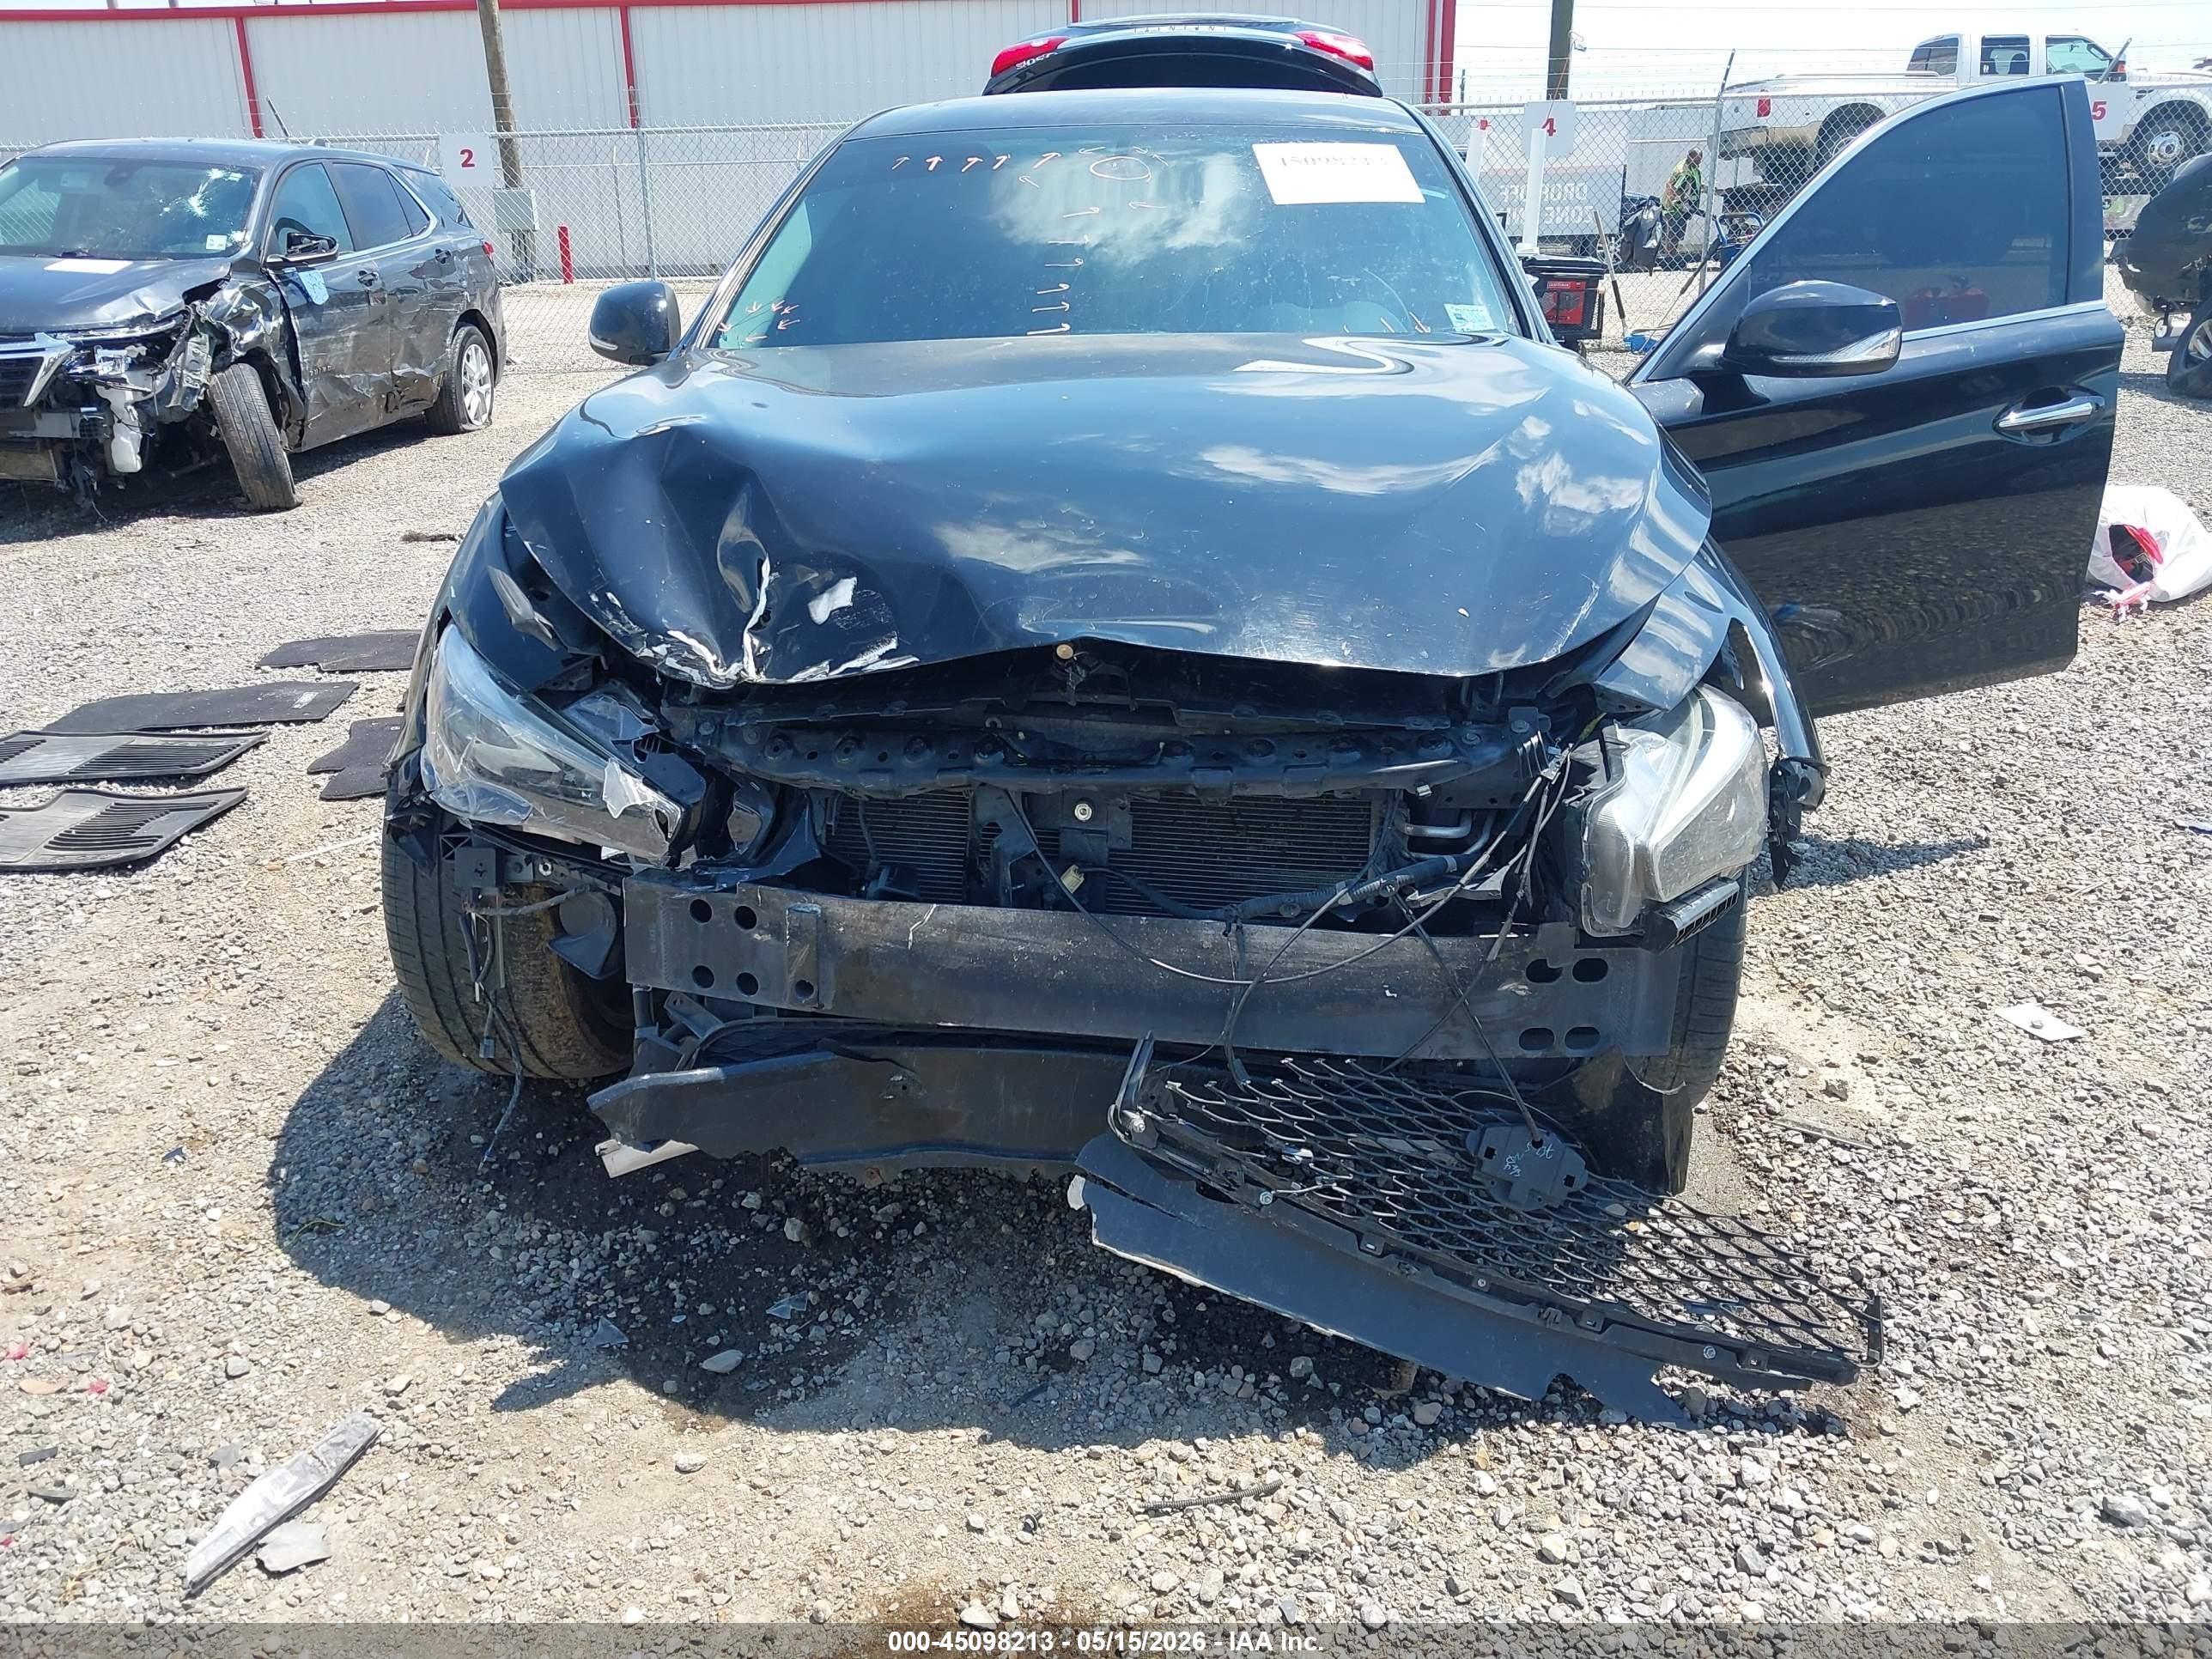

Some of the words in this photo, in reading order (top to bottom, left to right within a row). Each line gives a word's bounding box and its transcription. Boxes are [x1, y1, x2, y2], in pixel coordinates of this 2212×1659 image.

[2092, 101, 2107, 120] 5
[1541, 118, 1557, 137] 4
[460, 149, 476, 168] 2
